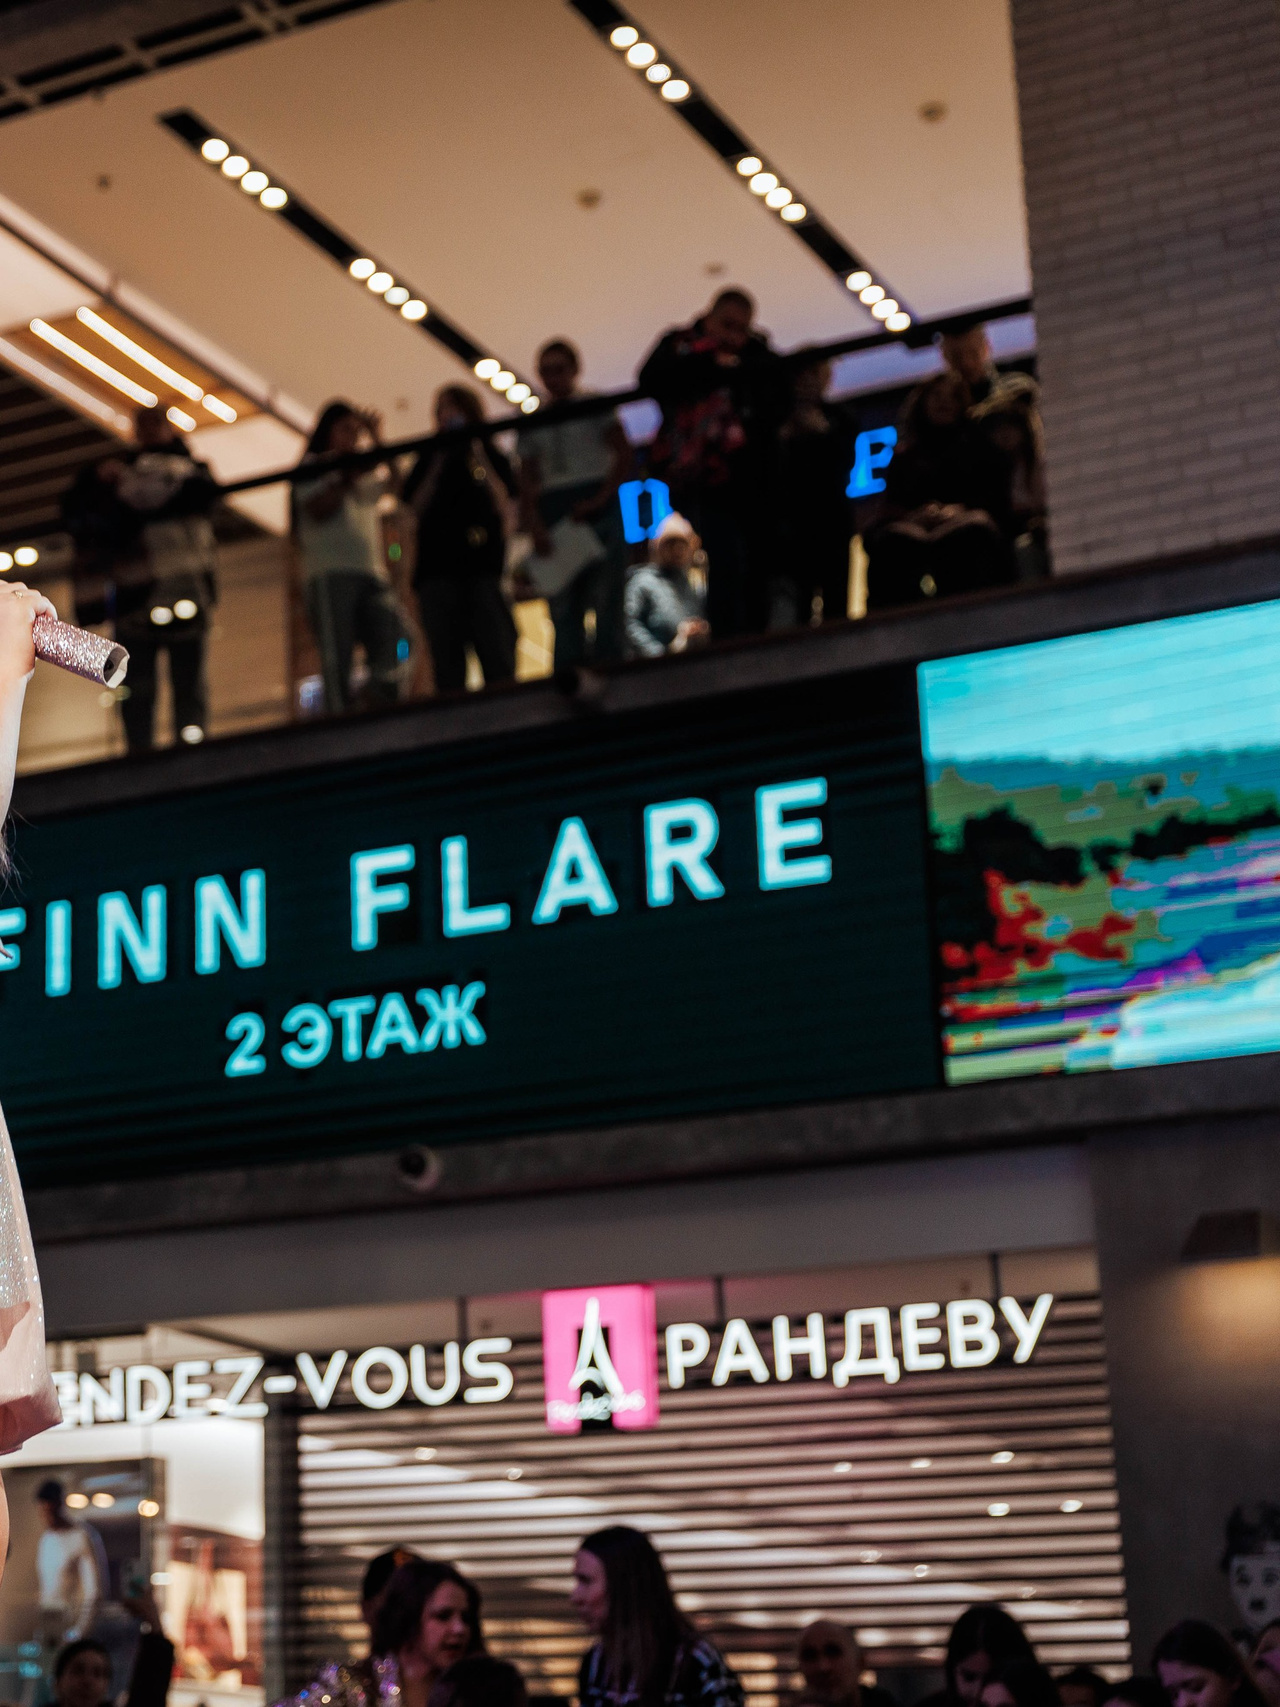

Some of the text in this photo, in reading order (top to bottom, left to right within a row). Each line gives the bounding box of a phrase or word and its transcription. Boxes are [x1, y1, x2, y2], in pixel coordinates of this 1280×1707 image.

[350, 776, 832, 951] FLARE
[225, 981, 487, 1077] 2 ЭТАЖ
[665, 1293, 1054, 1388] РАНДЕВУ
